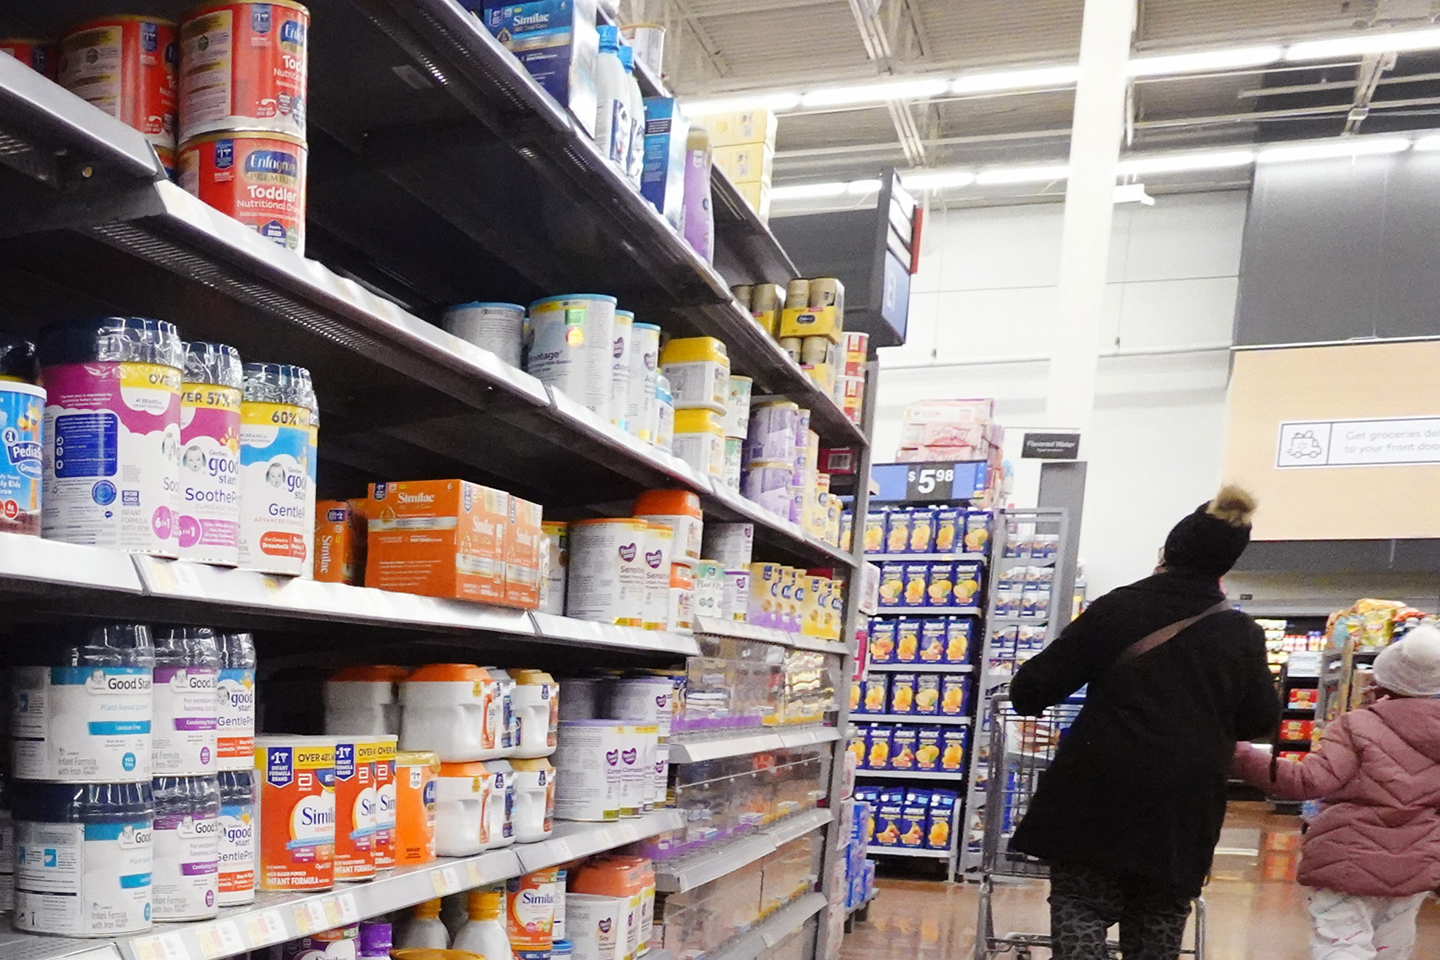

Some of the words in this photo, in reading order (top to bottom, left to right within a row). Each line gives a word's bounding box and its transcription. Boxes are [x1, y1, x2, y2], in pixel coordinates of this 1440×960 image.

[513, 13, 550, 27] Similac
[247, 184, 297, 203] Toddler
[237, 199, 286, 211] Nutritional
[271, 410, 298, 426] 60%
[1346, 431, 1367, 441] Get
[1369, 429, 1422, 442] groceries
[1026, 439, 1055, 448] Flavored
[1055, 440, 1076, 449] Water
[1344, 445, 1357, 453] to
[1358, 443, 1384, 454] your
[1387, 442, 1415, 452] front
[8, 480, 21, 489] Kids
[397, 491, 435, 504] Similac
[121, 516, 148, 525] FORMULA
[320, 534, 333, 574] Similac
[107, 677, 137, 691] Good
[189, 676, 211, 689] Good
[74, 756, 97, 766] Formula
[297, 753, 320, 763] OVER
[195, 822, 215, 834] Good
[228, 825, 252, 842] good
[266, 876, 290, 886] INFANT
[290, 876, 319, 886] FORMULA
